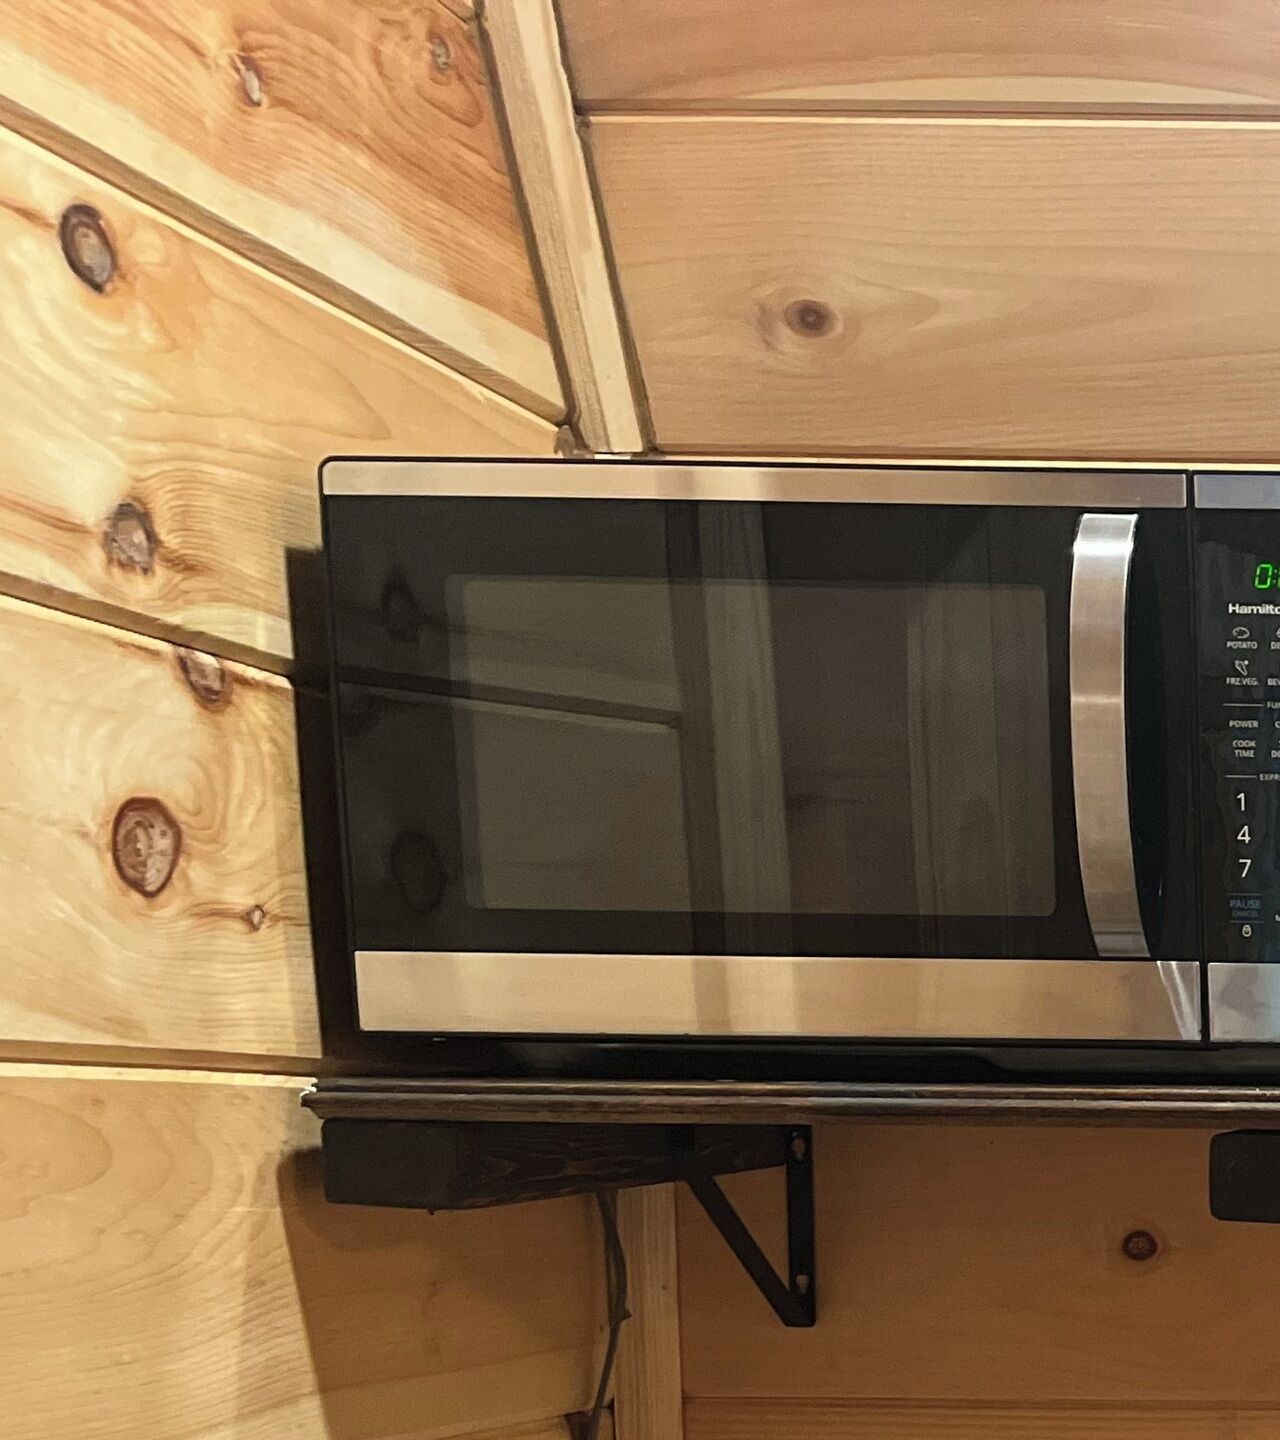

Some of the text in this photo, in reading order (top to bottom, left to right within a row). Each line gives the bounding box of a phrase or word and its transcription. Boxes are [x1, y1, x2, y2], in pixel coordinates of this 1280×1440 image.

[1226, 641, 1258, 649] POTATO
[1229, 720, 1259, 728] POWER
[1232, 739, 1256, 747] COOK
[1234, 749, 1255, 757] TIME
[1236, 792, 1246, 811] 1
[1237, 825, 1251, 844] 4
[1238, 858, 1252, 878] 7
